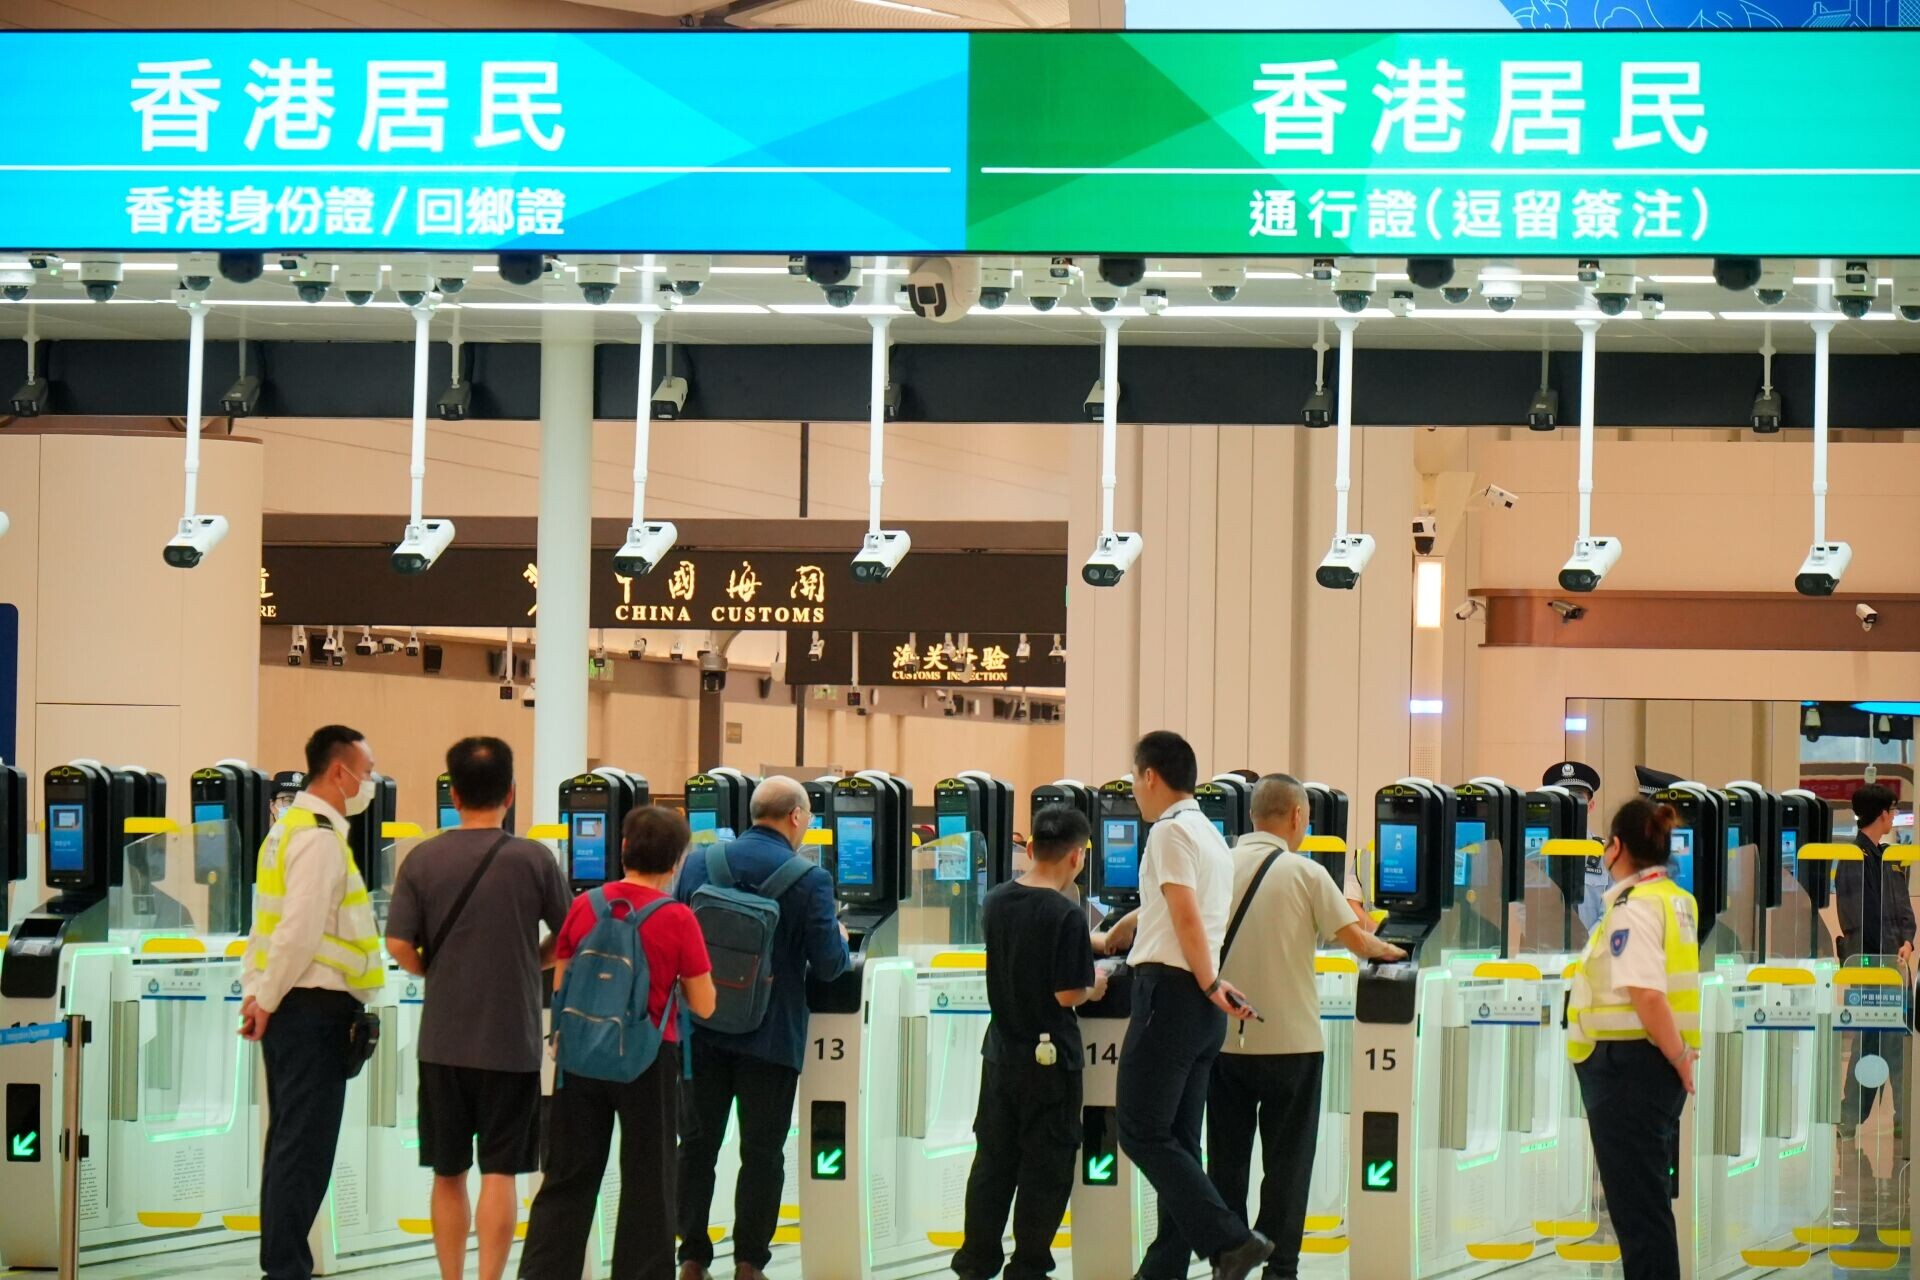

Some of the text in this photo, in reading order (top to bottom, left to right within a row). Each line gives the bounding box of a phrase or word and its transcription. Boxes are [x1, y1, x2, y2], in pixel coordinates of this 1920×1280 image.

[130, 58, 566, 152] 香港居民
[1252, 59, 1709, 155] 香港居民
[1249, 188, 1709, 241] 通行證(逗留簽注)
[615, 604, 825, 623] CHINA CUSTOMS
[892, 670, 1008, 681] CUSTOMS INSECTION
[813, 1038, 845, 1061] 13
[1086, 1042, 1118, 1066] 14
[1364, 1048, 1397, 1071] 15
